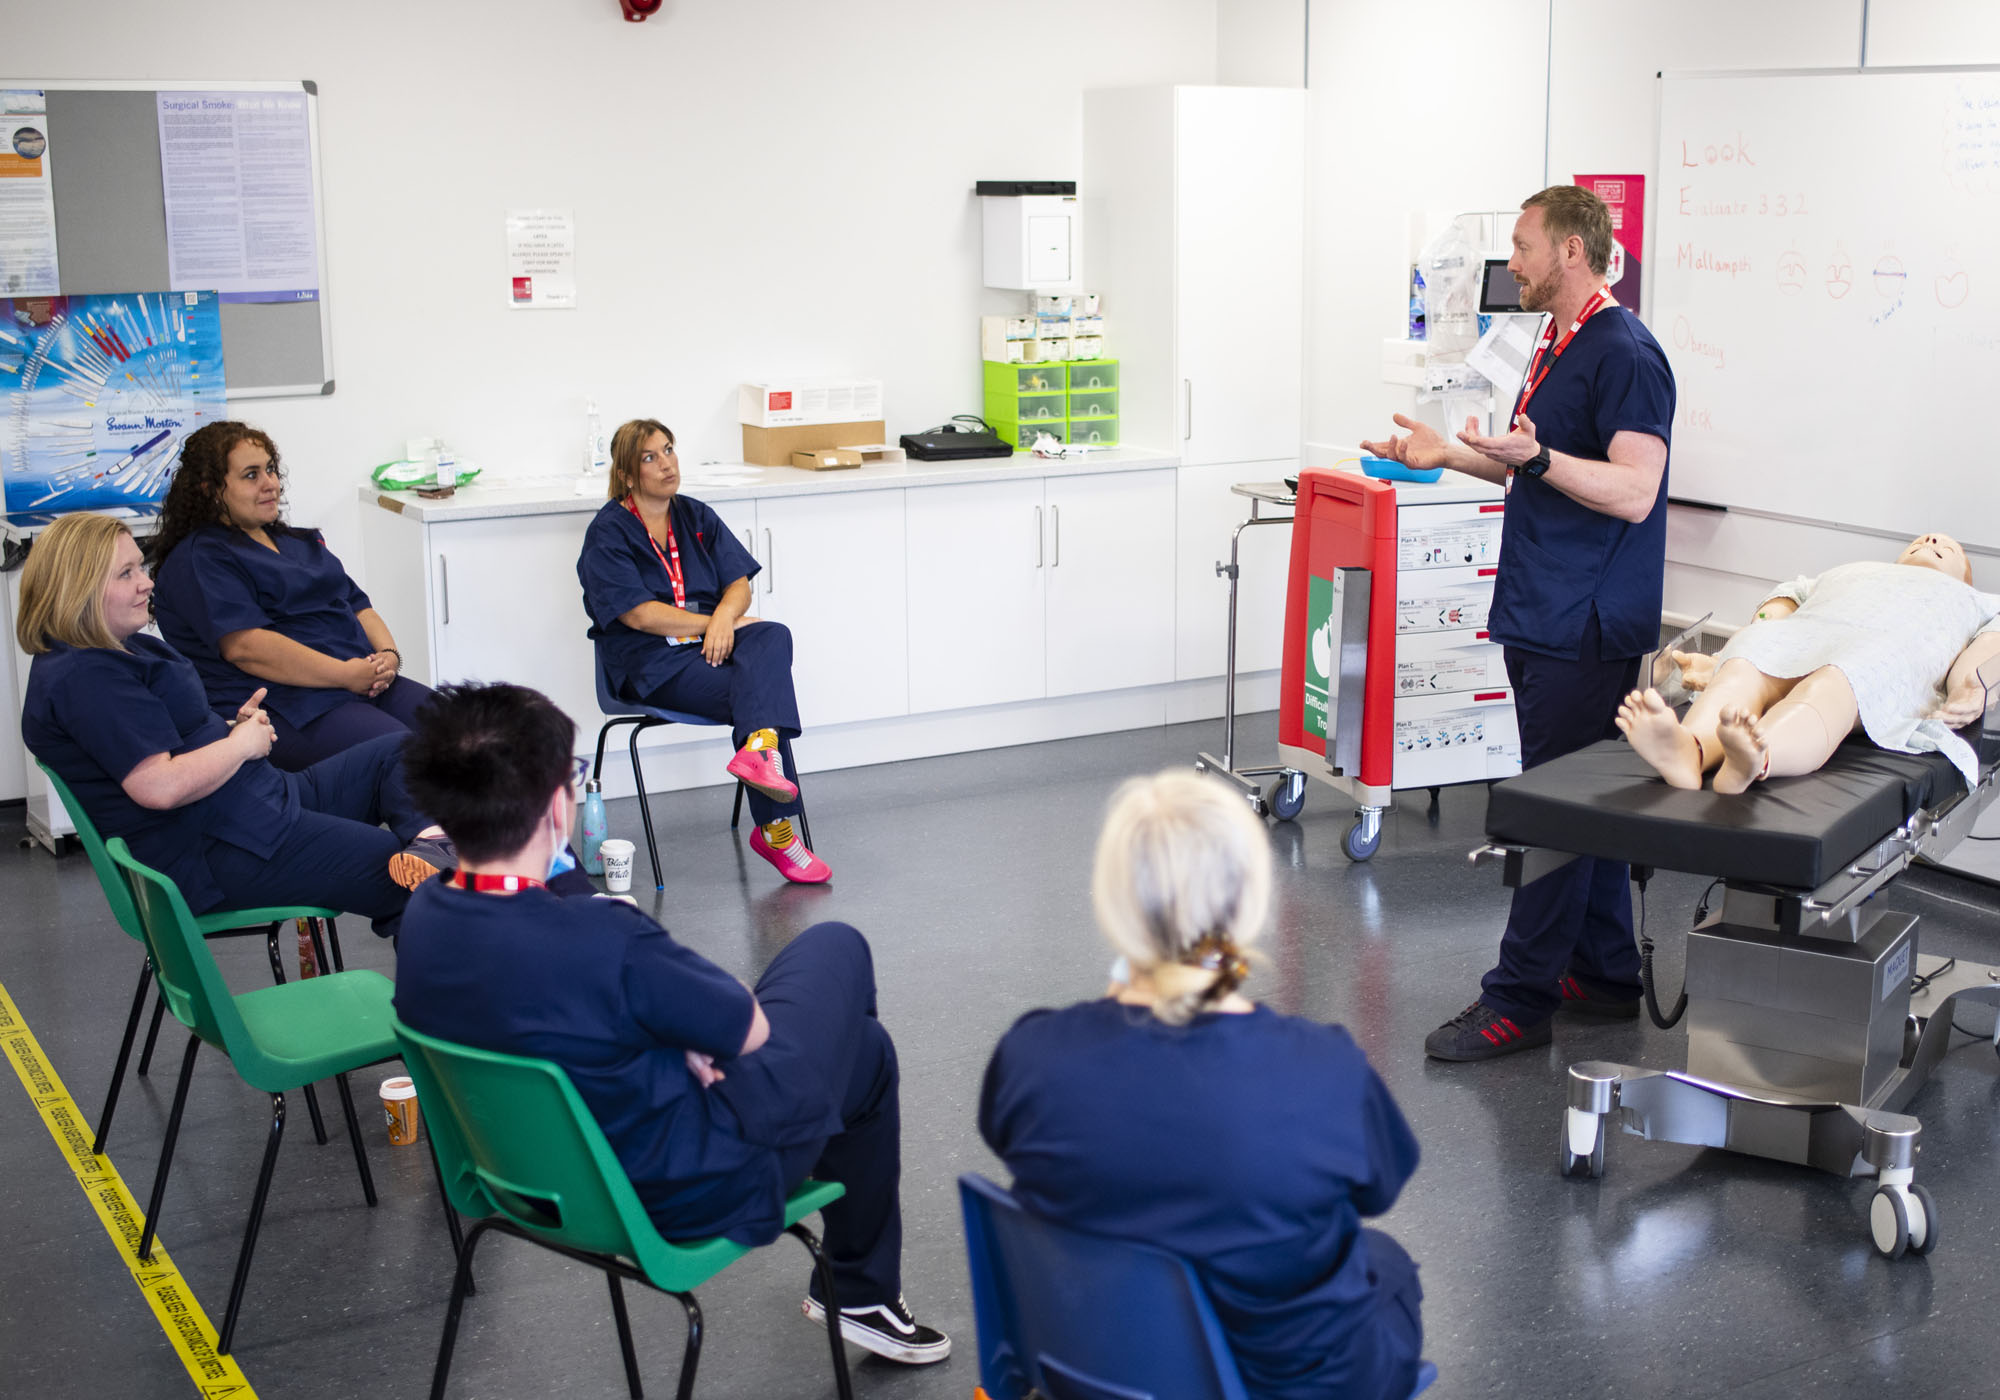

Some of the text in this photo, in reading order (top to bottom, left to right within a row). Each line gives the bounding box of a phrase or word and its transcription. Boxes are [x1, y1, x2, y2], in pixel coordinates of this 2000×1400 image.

[163, 100, 199, 112] Surgical
[1682, 129, 1757, 168] Look
[106, 416, 182, 431] Swann-Morton
[606, 857, 630, 867] Black
